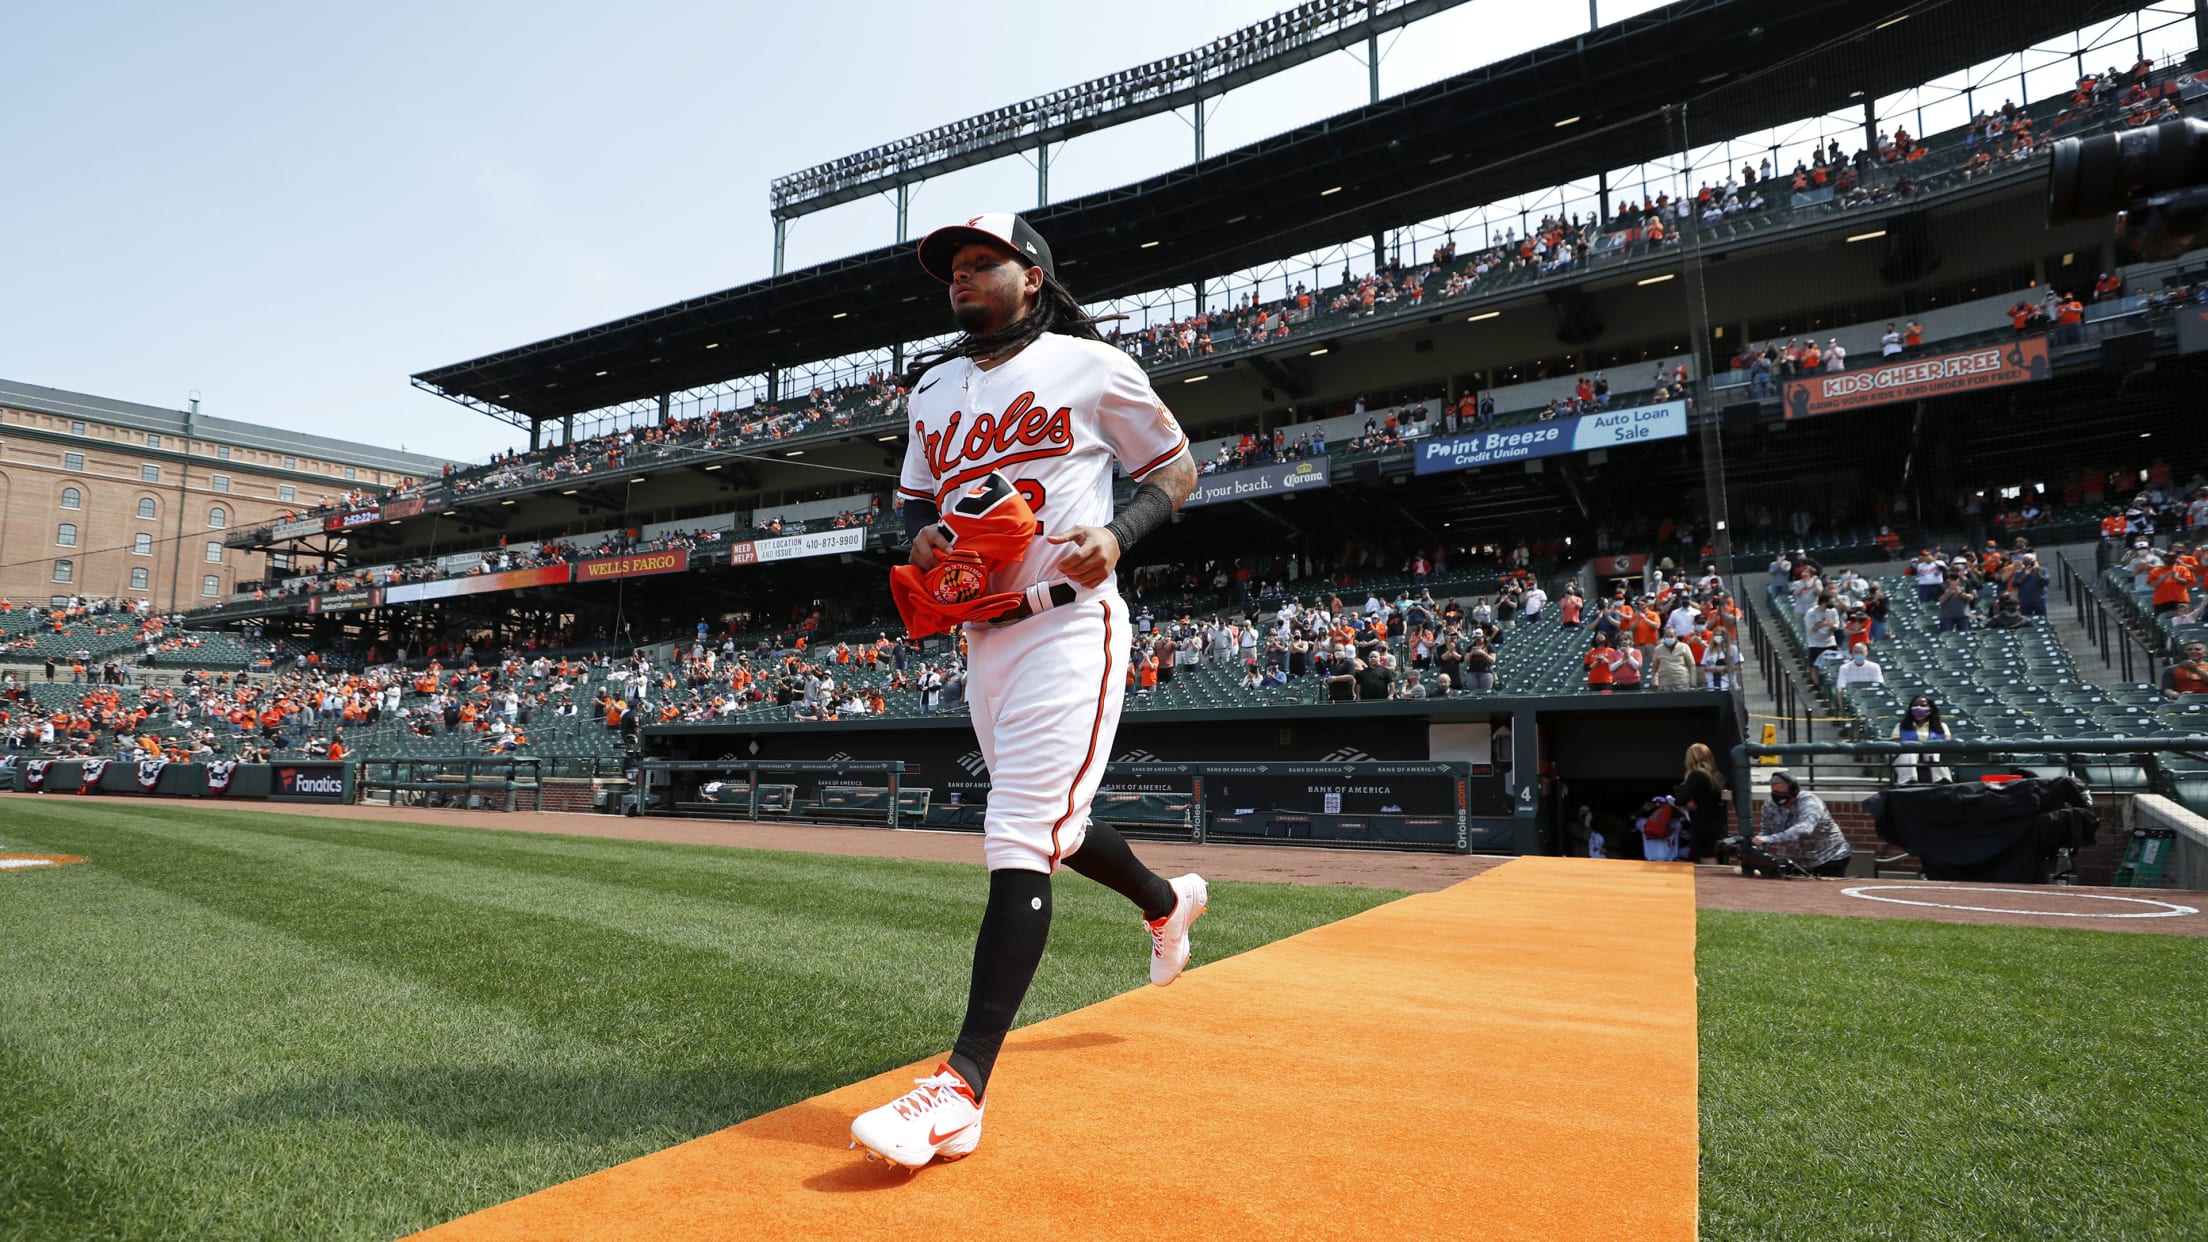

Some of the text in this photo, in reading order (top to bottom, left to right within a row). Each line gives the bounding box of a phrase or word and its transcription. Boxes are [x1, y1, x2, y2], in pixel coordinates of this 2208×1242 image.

[1823, 350, 2000, 398] KIDS CHEER FREE
[1841, 395, 1868, 405] YOUR
[1871, 390, 1894, 399] KIDS
[1905, 385, 1927, 394] AND
[1930, 379, 1965, 391] UNDER
[1968, 376, 1989, 385] FOR
[1992, 370, 2021, 380] FREE!
[1594, 408, 1669, 428] Auto Loan
[1614, 425, 1650, 441] Sale
[1426, 427, 1560, 459] Point Breeze
[1455, 446, 1529, 465] Credit Union
[1283, 472, 1323, 488] Corona
[1186, 475, 1273, 503] nd your beach.
[733, 543, 751, 553] NEED
[757, 538, 802, 550] TEXT LOCATION
[806, 535, 859, 550] 410-873-9900
[733, 553, 754, 563] HELP?
[761, 551, 774, 560] AND
[775, 548, 792, 558] ISSUE
[588, 555, 675, 576] WELLS FARGO
[944, 563, 983, 578] ORIOLES
[296, 774, 342, 793] Fanatics
[1521, 786, 1532, 802] 4
[1457, 781, 1467, 849] Orioles.com
